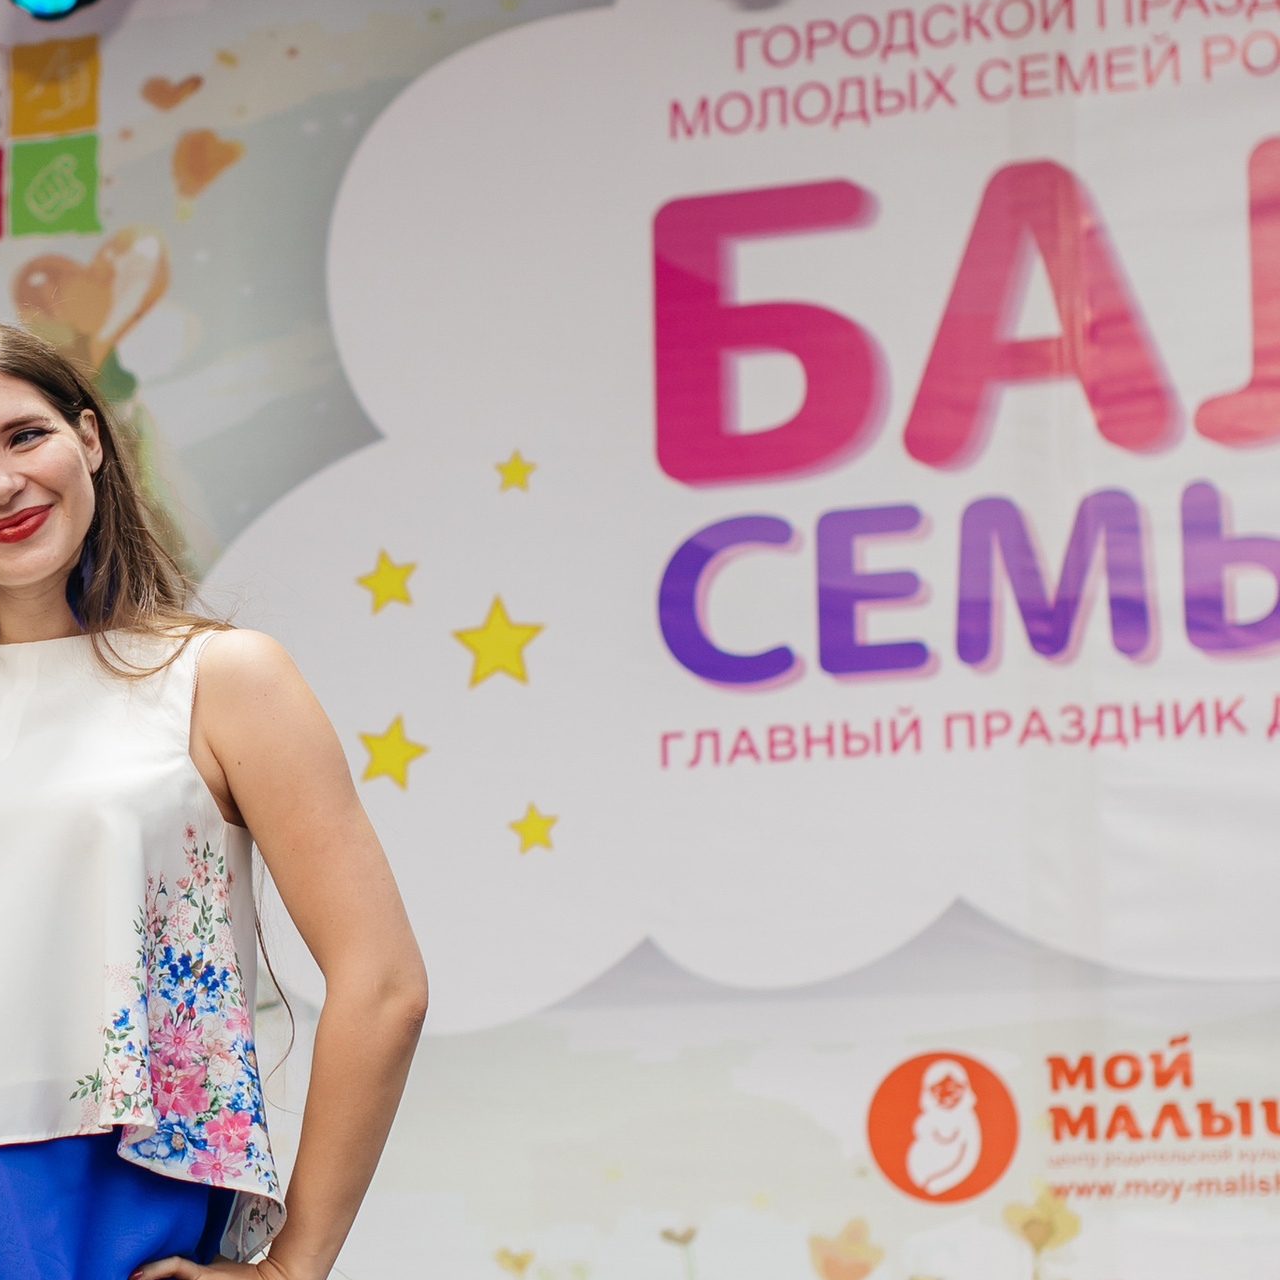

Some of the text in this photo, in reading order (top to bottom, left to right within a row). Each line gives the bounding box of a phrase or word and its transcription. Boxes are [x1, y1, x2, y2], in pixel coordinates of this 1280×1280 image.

[668, 65, 958, 141] МОЛОДЫХ
[975, 32, 1181, 105] СЕМЕЙ
[657, 478, 1280, 688] СЕМЬ
[660, 704, 922, 769] ГЛАВНЫЙ
[944, 693, 1248, 752] ПРАЗДНИК
[1046, 1032, 1194, 1093] МОЙ
